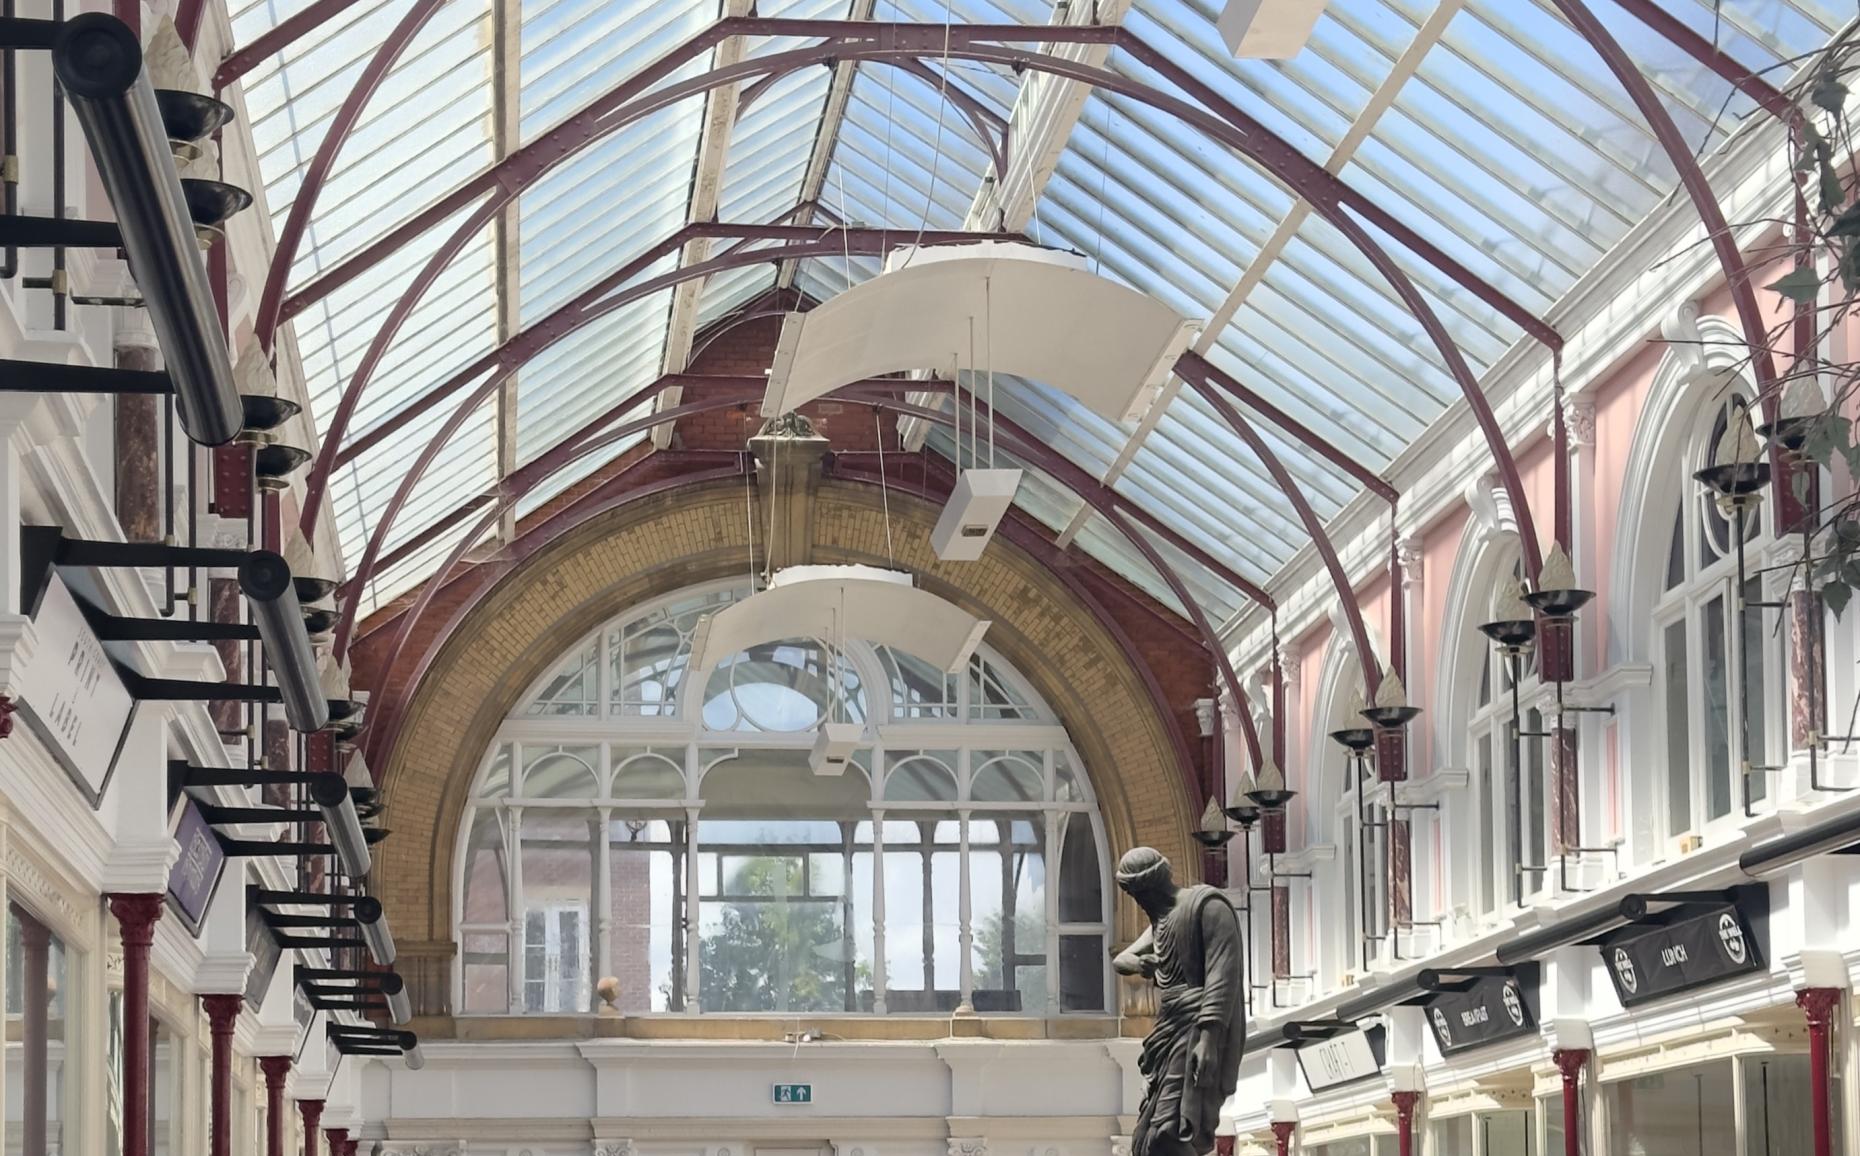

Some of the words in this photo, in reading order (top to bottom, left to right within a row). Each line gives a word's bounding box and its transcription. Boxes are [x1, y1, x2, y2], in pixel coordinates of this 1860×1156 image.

[67, 640, 100, 697] PRINT
[49, 692, 82, 746] LABEL
[1661, 944, 1688, 967] LUNCH
